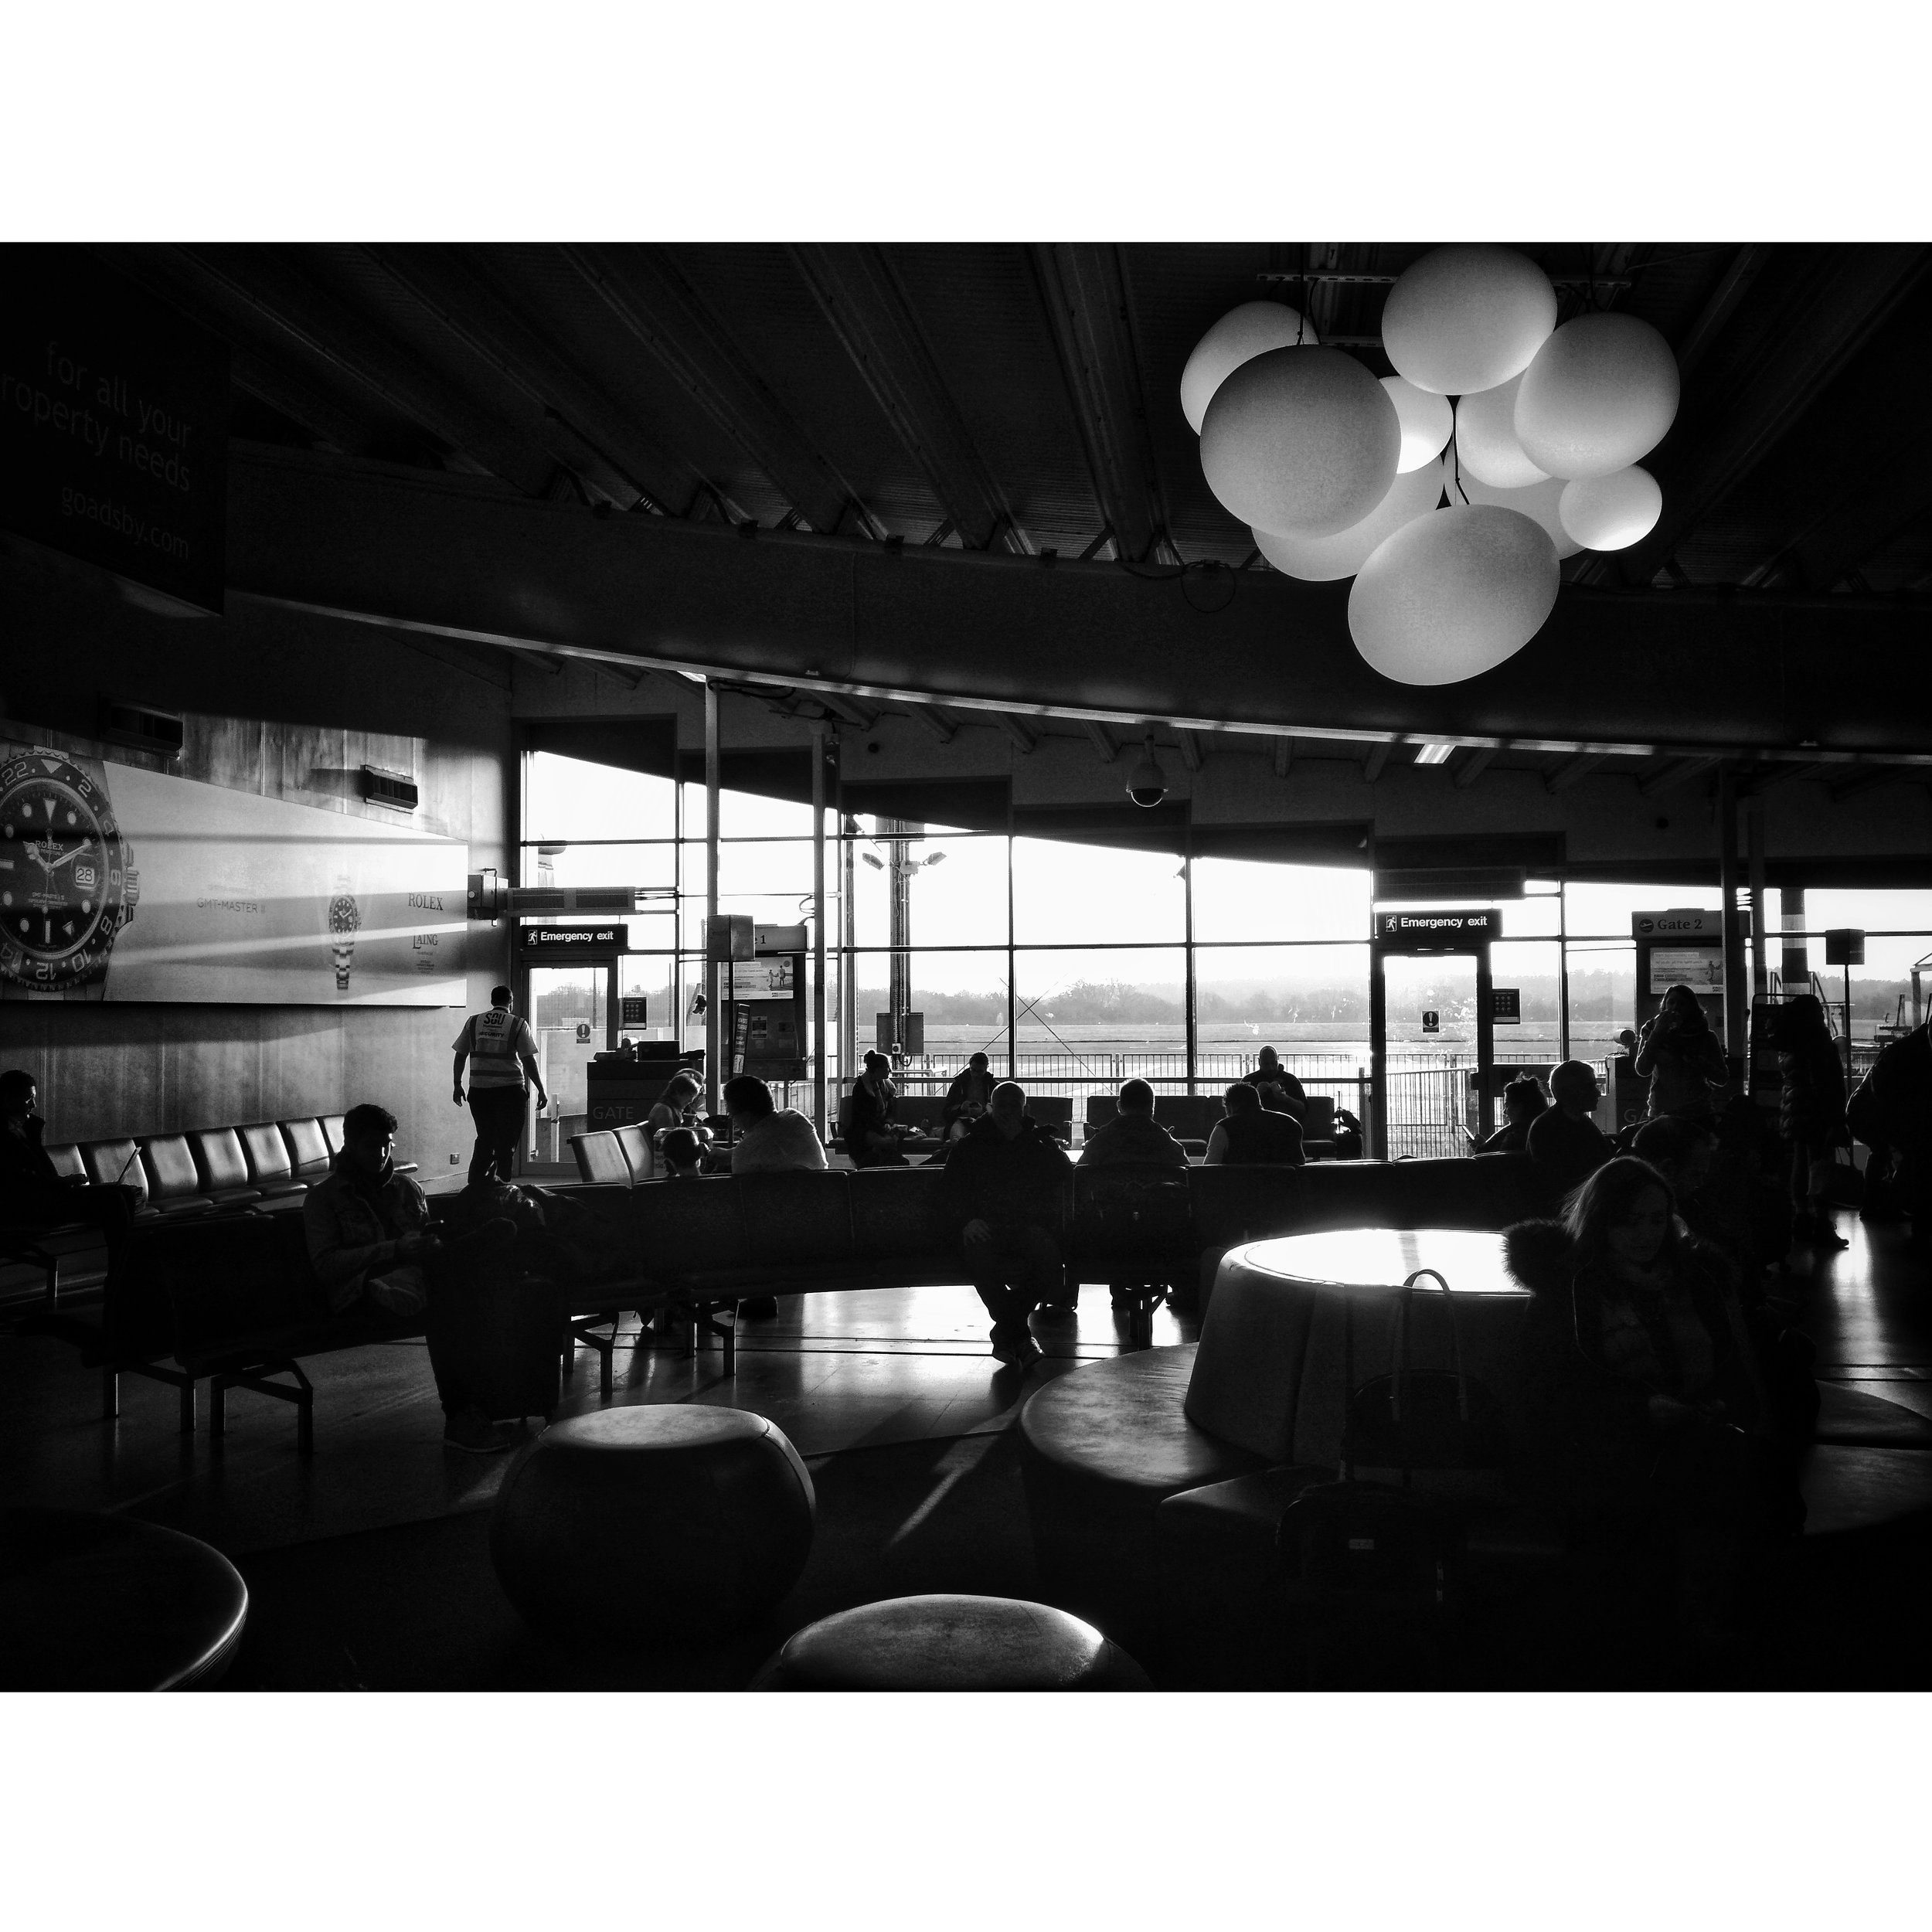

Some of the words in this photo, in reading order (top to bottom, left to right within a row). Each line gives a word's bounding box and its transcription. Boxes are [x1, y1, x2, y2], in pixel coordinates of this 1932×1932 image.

[45, 340, 87, 390] for
[97, 375, 130, 417] all
[139, 396, 192, 448] your
[119, 435, 190, 492] needs
[61, 486, 189, 562] goadsby.com
[36, 840, 63, 851] ROLEX
[77, 868, 93, 882] 28
[196, 897, 258, 913] GMT-MASTER
[408, 893, 444, 911] ROLEX
[1400, 917, 1463, 929] Emergency
[1468, 916, 1488, 927] exit
[1657, 919, 1691, 930] Gate
[1694, 919, 1703, 930] 2
[412, 934, 439, 949] LAING
[540, 931, 594, 942] Emergency
[597, 930, 614, 940] exit
[760, 934, 767, 944] 1
[593, 1106, 634, 1120] GATE
[1624, 1108, 1651, 1124] GA
